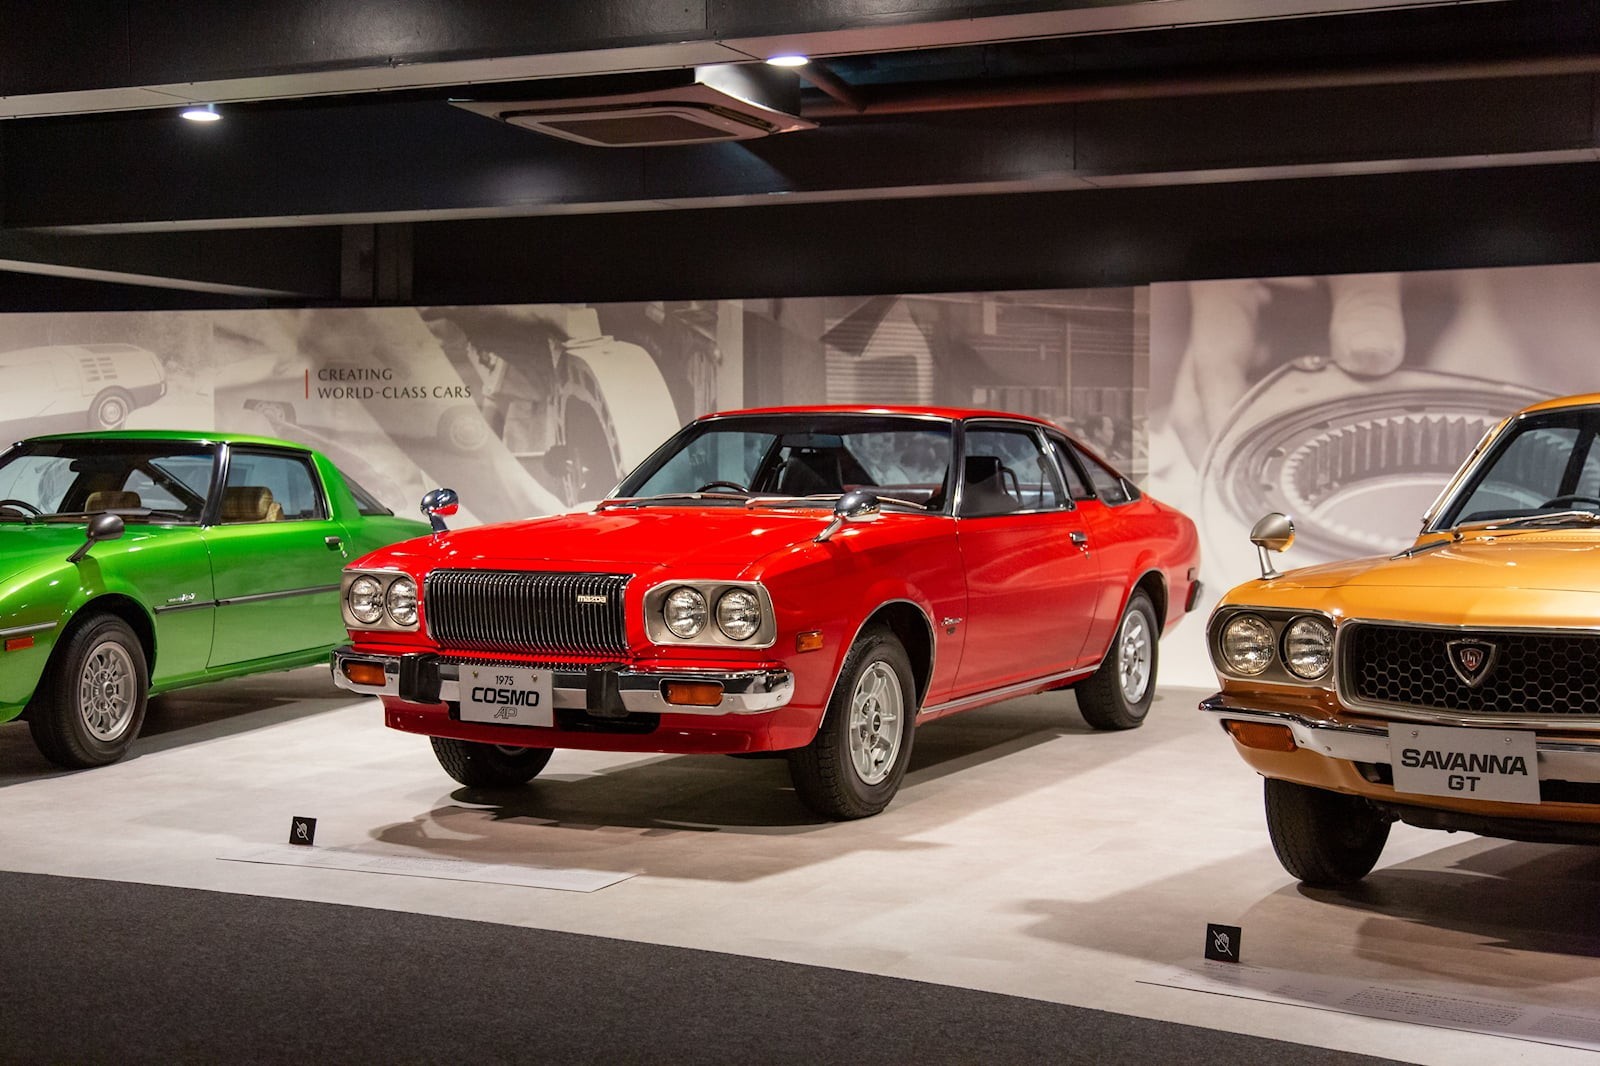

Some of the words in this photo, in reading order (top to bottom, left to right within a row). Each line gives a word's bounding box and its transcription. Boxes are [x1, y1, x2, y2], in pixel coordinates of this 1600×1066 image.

[317, 368, 393, 381] CREATING
[317, 386, 427, 399] WORLD-CLASS
[432, 386, 472, 399] CARS
[495, 675, 514, 686] 1975
[471, 687, 540, 707] COSMO
[1401, 748, 1528, 776] SAVANNA
[1447, 775, 1481, 792] GT
